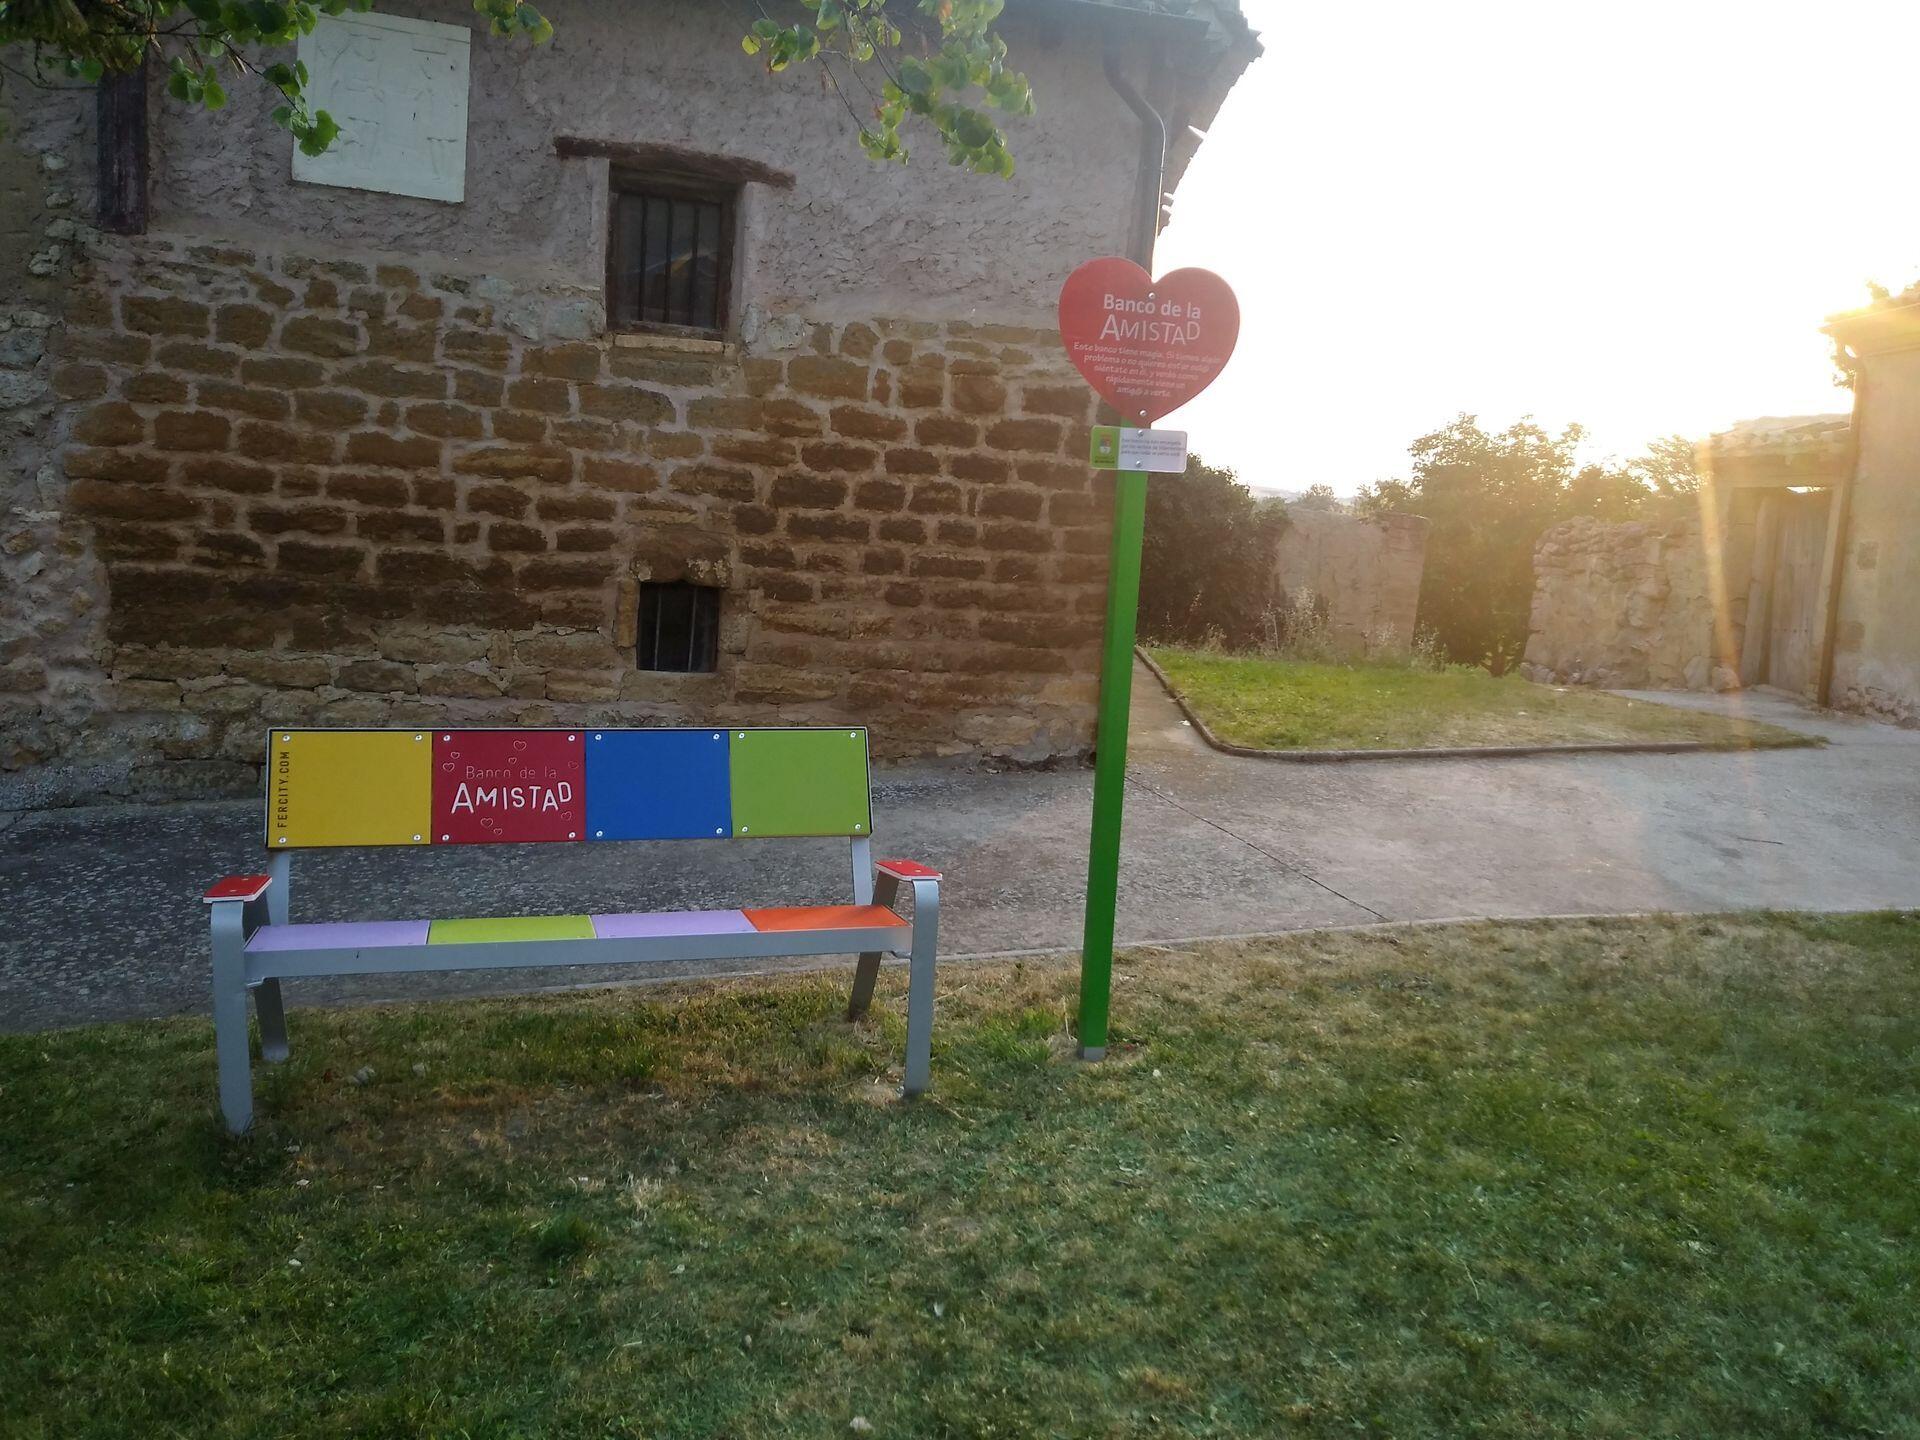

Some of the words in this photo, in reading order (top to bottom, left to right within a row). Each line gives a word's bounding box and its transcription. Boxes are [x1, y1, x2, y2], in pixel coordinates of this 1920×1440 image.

[1104, 293, 1155, 314] Banco
[1160, 299, 1181, 317] de
[1186, 302, 1201, 320] la
[1099, 314, 1201, 345] AMISTAD
[1084, 354, 1120, 364] problema
[466, 764, 511, 780] Banco
[519, 765, 536, 780] de
[544, 765, 557, 780] la
[277, 750, 290, 829] FERCITY.COM
[450, 780, 573, 815] AMISTAD
